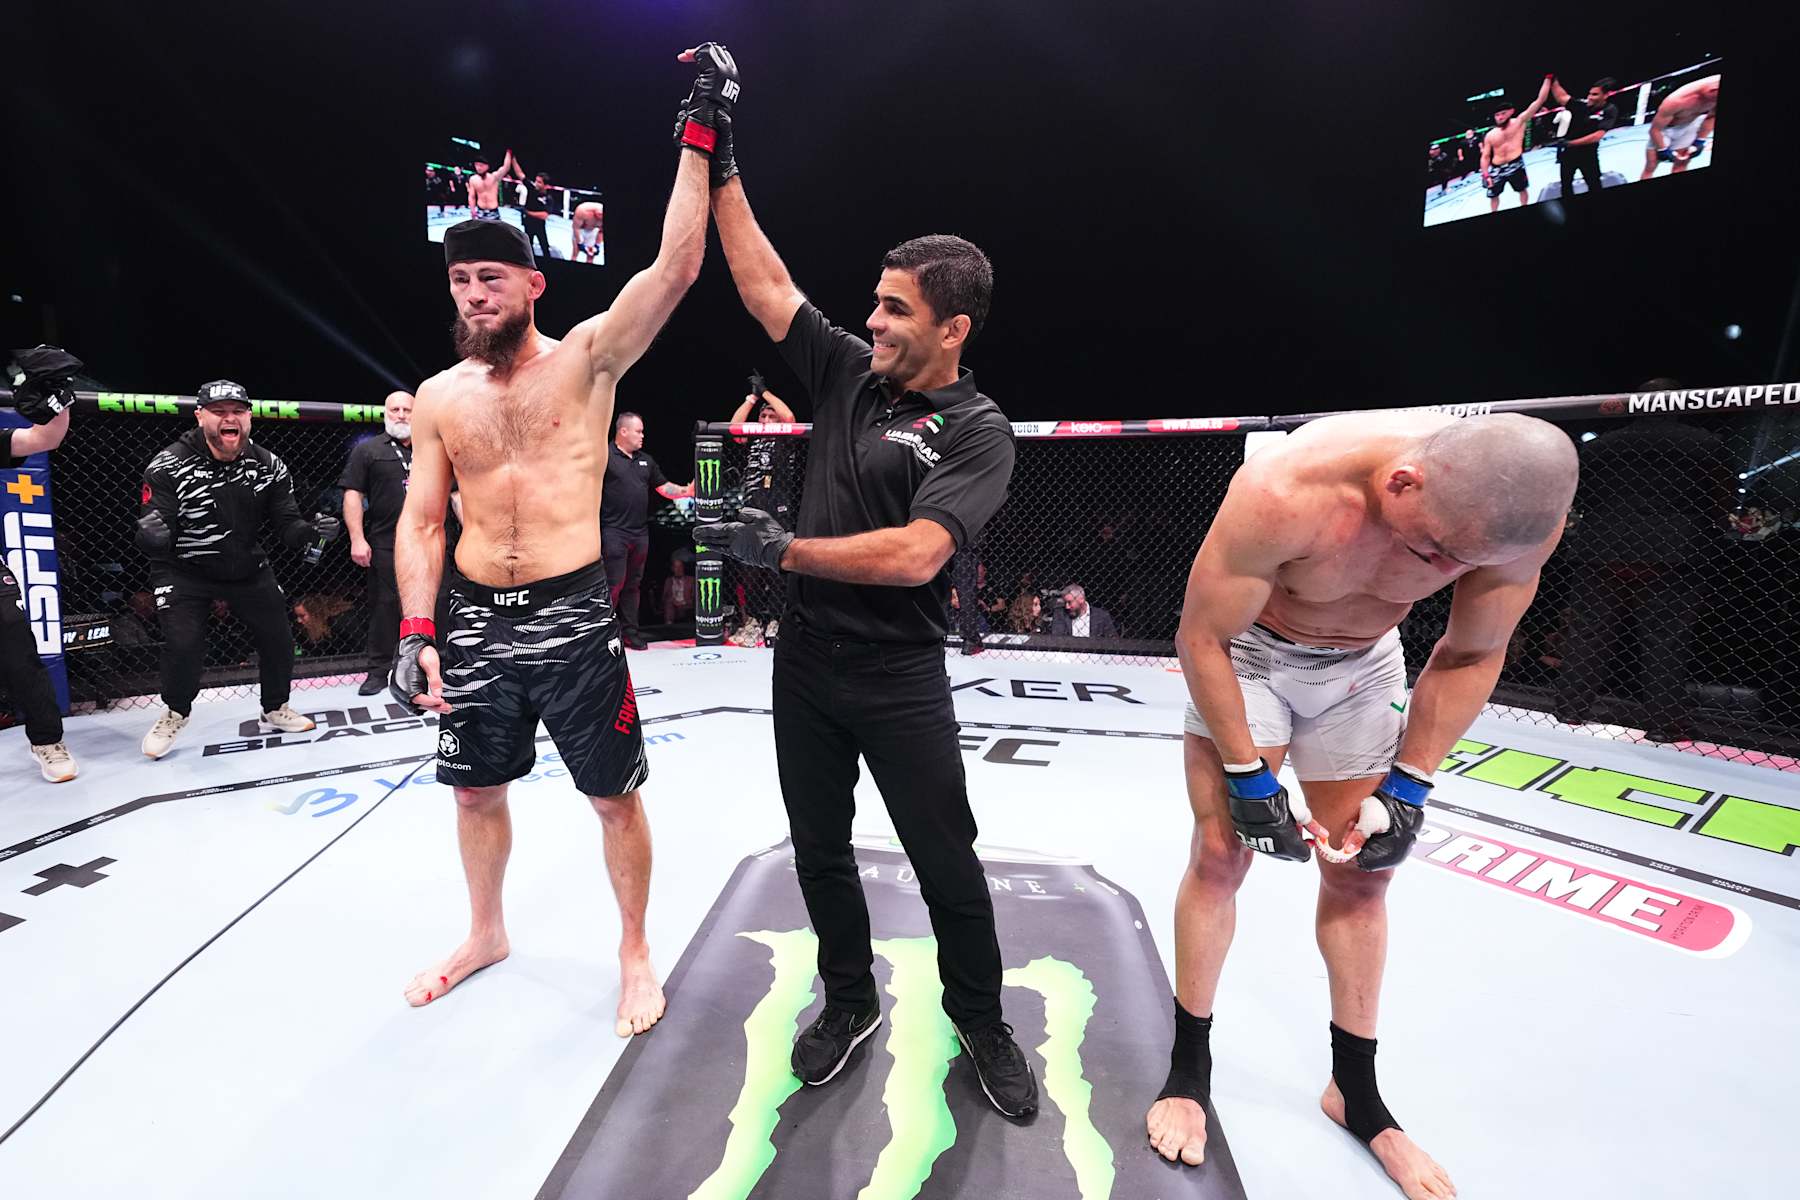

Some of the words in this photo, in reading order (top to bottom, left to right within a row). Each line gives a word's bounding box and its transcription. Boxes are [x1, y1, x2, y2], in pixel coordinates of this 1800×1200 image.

[721, 79, 740, 104] UF
[209, 385, 241, 398] UFC
[1628, 382, 1800, 414] MANSCAPED
[98, 392, 179, 415] KICK
[252, 400, 300, 419] ICK
[343, 403, 387, 422] KIC
[193, 469, 214, 479] UFC
[154, 585, 174, 595] UFC
[493, 589, 530, 607] UFC
